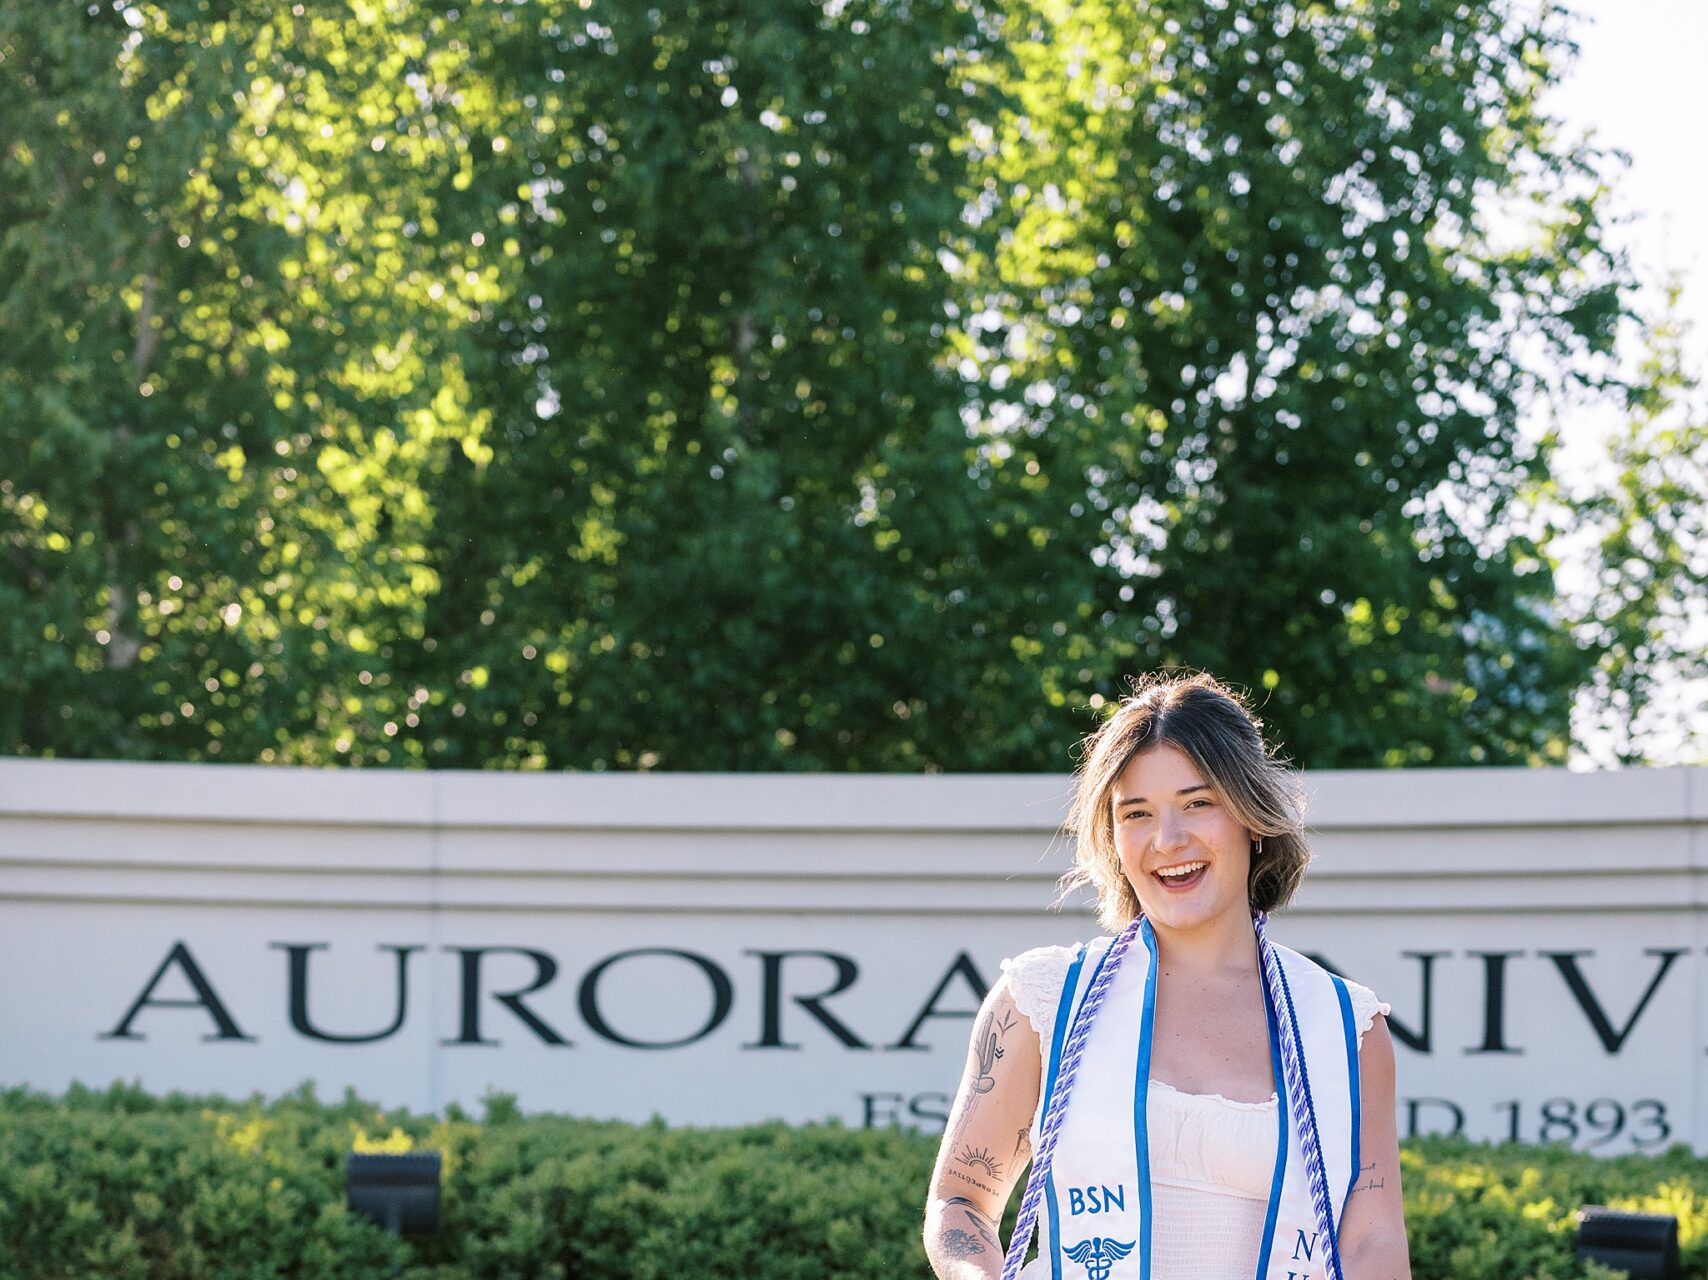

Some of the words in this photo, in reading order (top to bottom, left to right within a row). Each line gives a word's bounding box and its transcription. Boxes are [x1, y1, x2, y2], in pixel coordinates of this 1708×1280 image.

[96, 940, 990, 1051] AURORA
[1493, 1096, 1672, 1148] 1893
[1068, 1184, 1126, 1216] BSN
